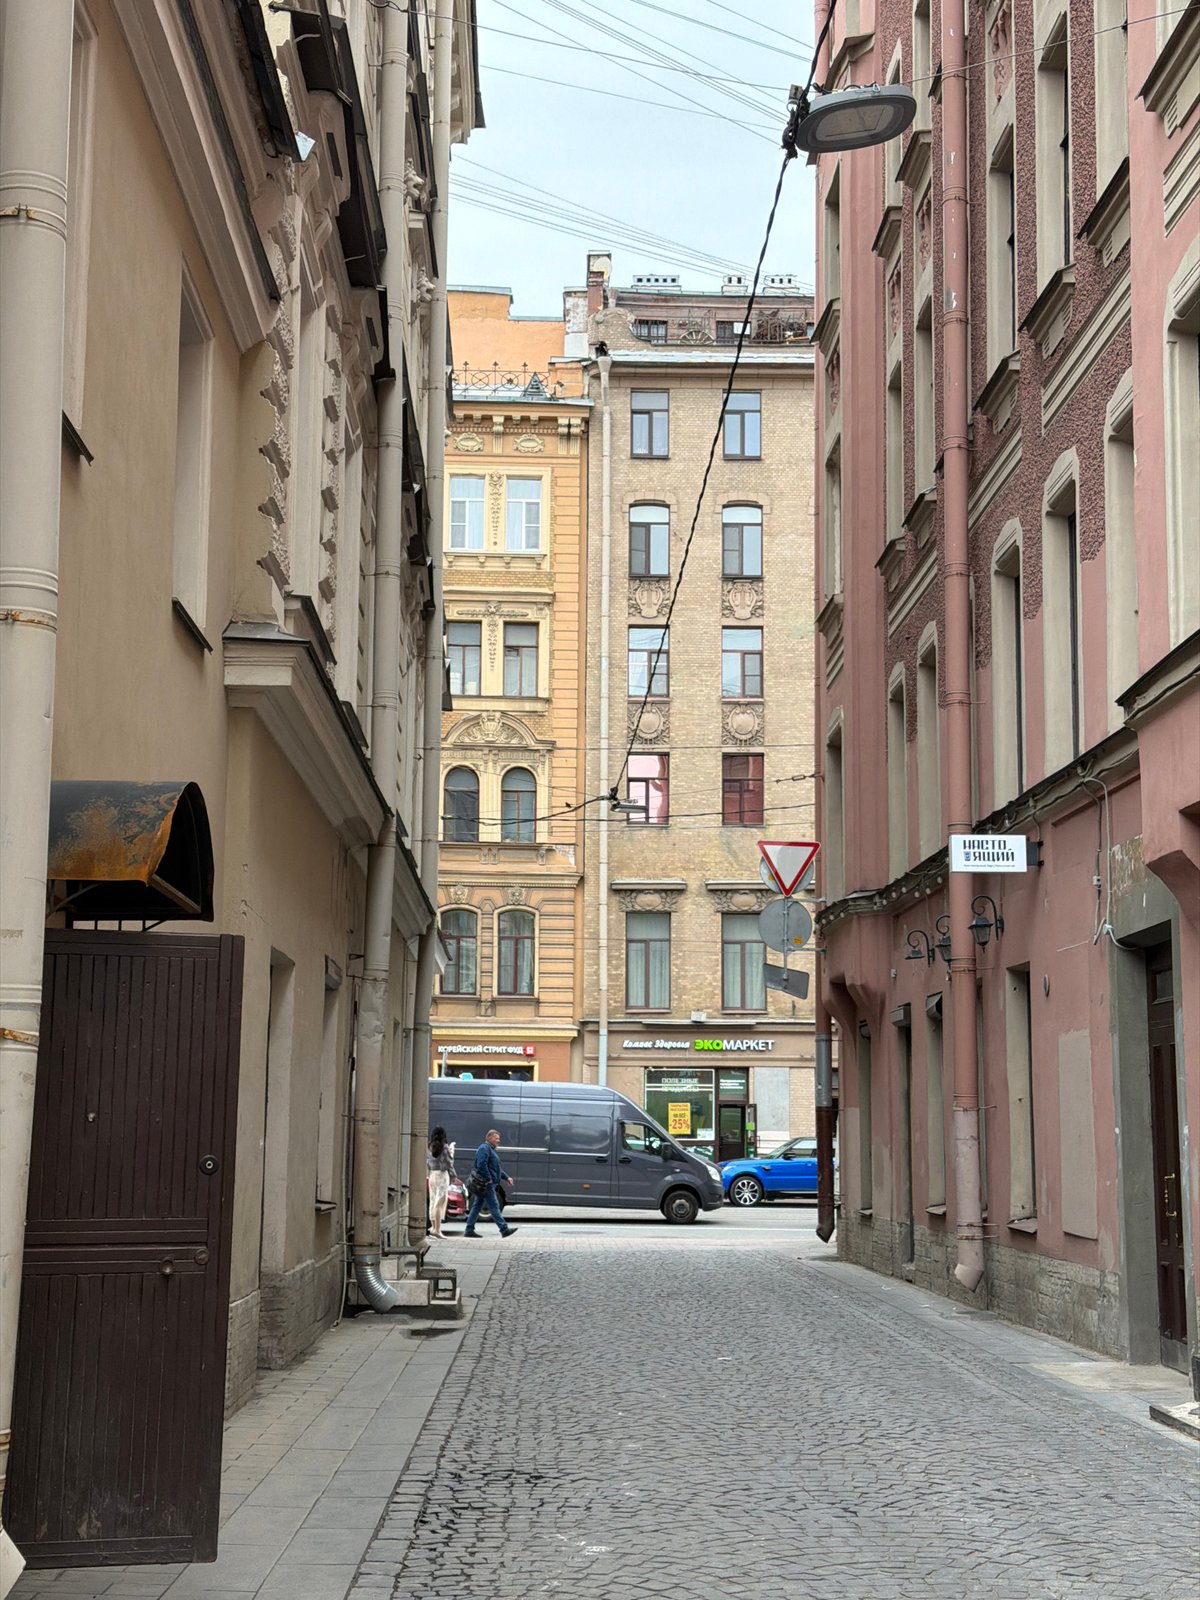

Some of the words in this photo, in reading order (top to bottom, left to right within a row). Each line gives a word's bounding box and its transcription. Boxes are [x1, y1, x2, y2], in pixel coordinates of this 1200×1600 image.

[973, 851, 1015, 862] ЯЩИЙ
[438, 1045, 482, 1053] КОРЕЙСКИЙ
[507, 1046, 523, 1054] ФУД
[694, 1039, 774, 1051] ЭКОМАРКЕТ
[669, 1118, 690, 1130] -25%
